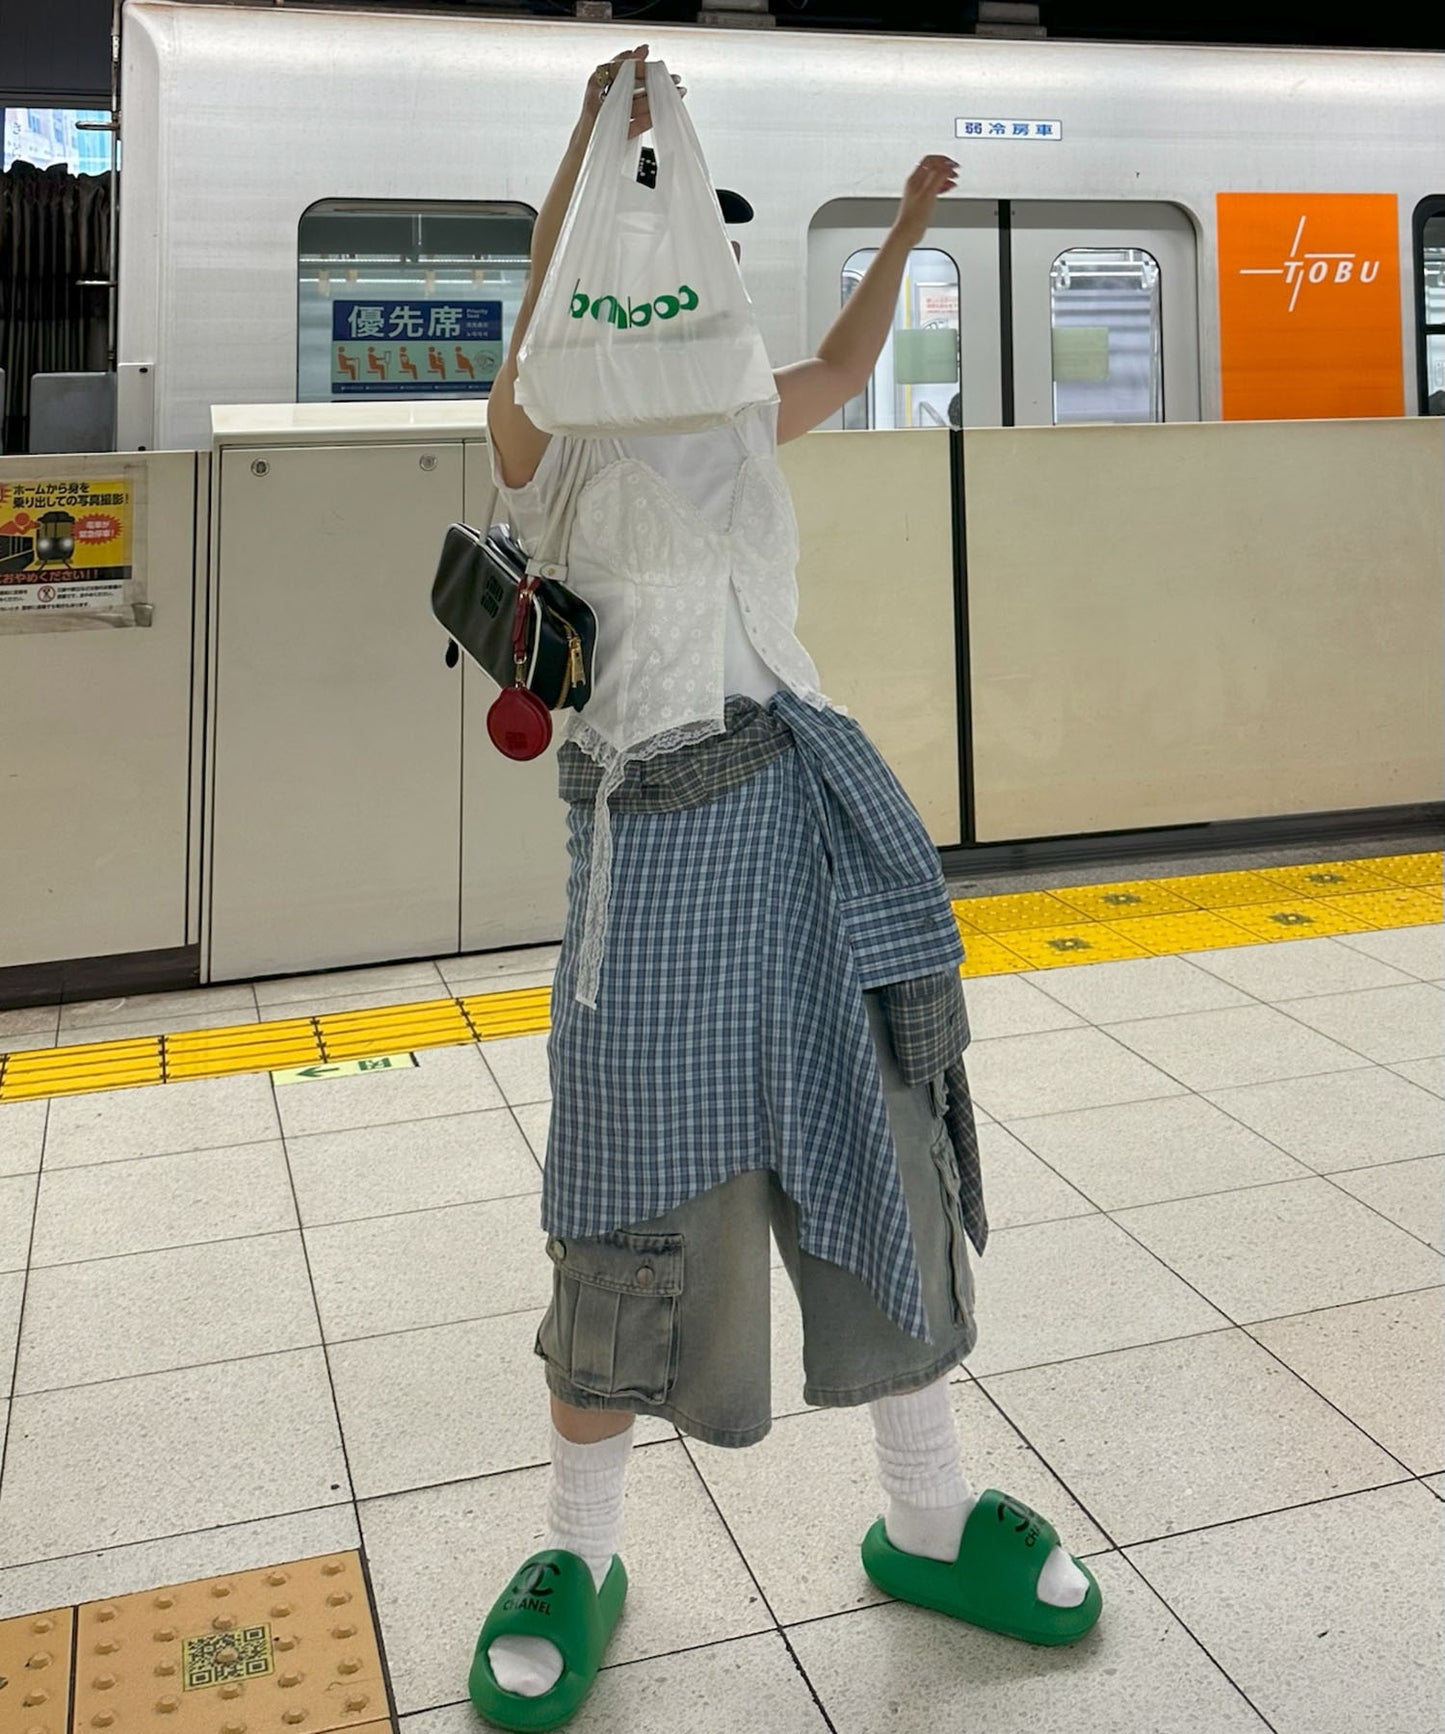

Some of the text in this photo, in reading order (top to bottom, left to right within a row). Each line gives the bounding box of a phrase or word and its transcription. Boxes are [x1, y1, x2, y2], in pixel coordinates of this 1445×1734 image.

[965, 122, 1053, 136] 弱冷房車
[1284, 261, 1380, 283] TOBU
[348, 305, 463, 338] 優先席
[13, 482, 90, 495] ホームから身を
[503, 1598, 551, 1616] CHANEL
